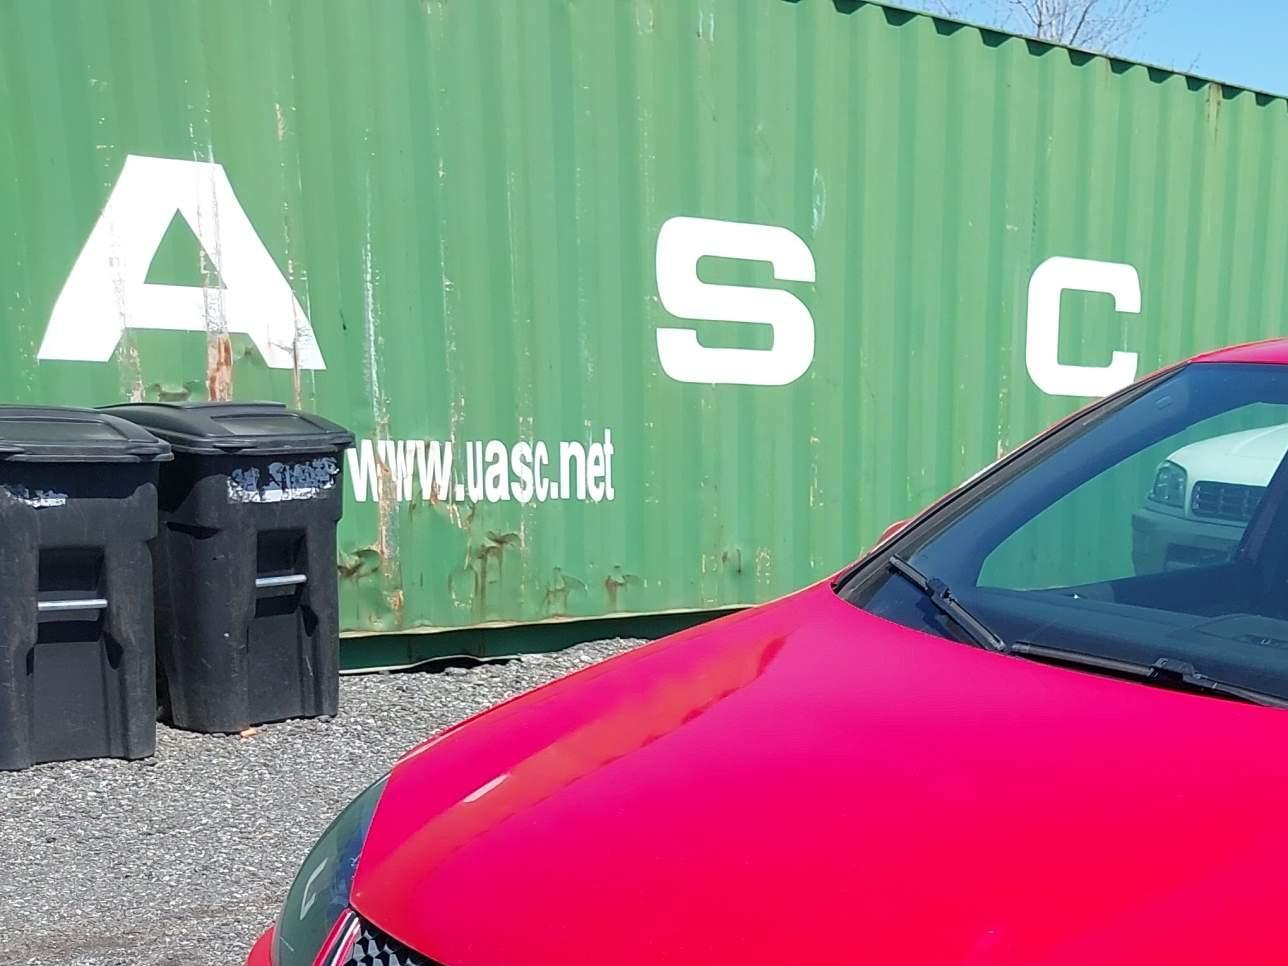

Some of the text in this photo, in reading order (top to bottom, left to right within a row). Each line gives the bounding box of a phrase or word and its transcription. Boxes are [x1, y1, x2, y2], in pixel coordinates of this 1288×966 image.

[37, 154, 1142, 398] A S C
[346, 429, 615, 503] www.uasc.net
